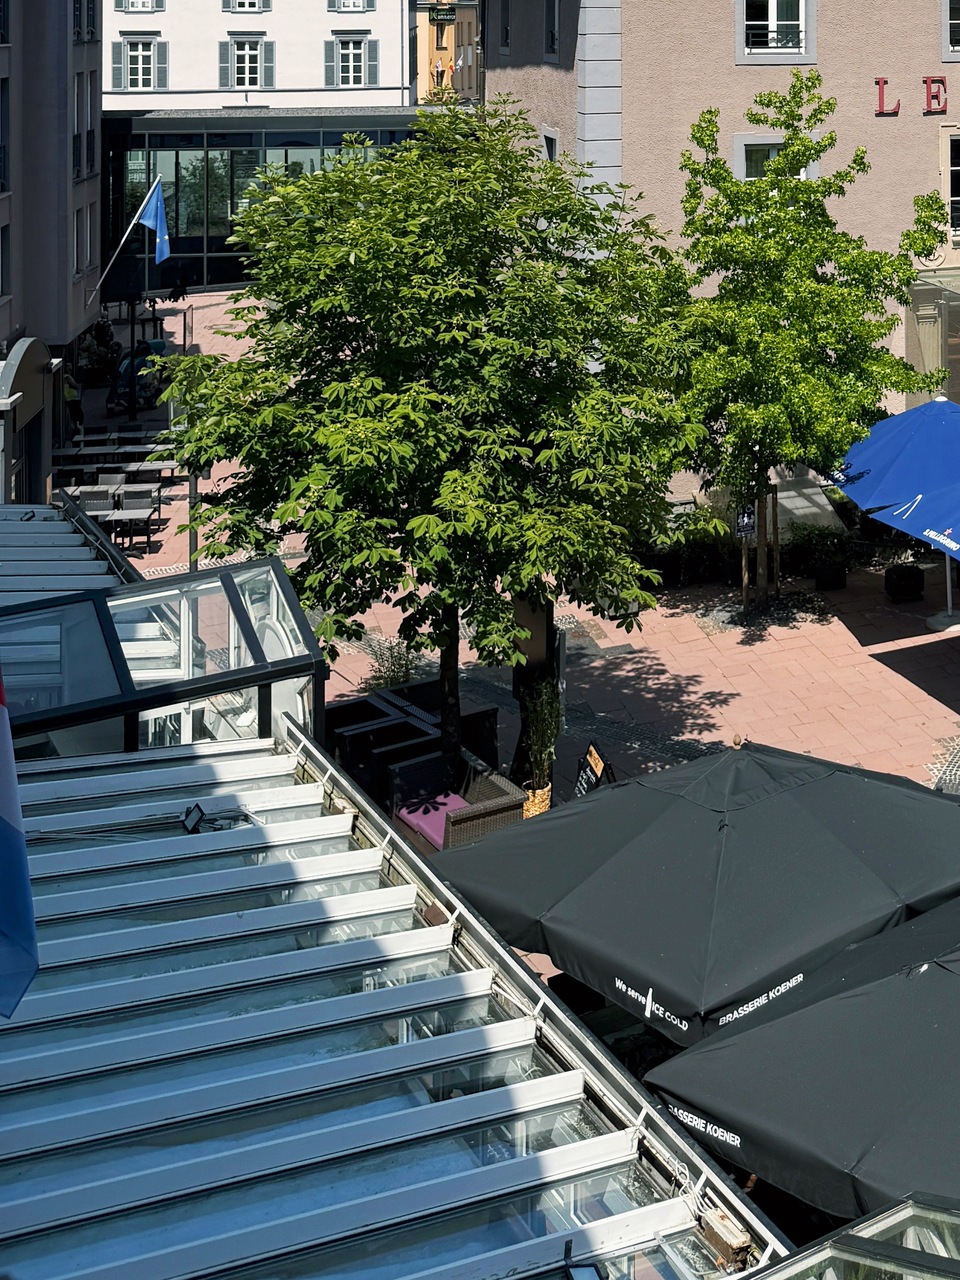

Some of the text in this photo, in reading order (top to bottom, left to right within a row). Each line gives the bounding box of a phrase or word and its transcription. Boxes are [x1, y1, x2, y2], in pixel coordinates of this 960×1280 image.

[874, 76, 948, 115] LE
[614, 976, 689, 1032] We serve ICE COLD
[719, 973, 804, 1026] BRASSERIE KOENER
[706, 1121, 741, 1148] KOENER
